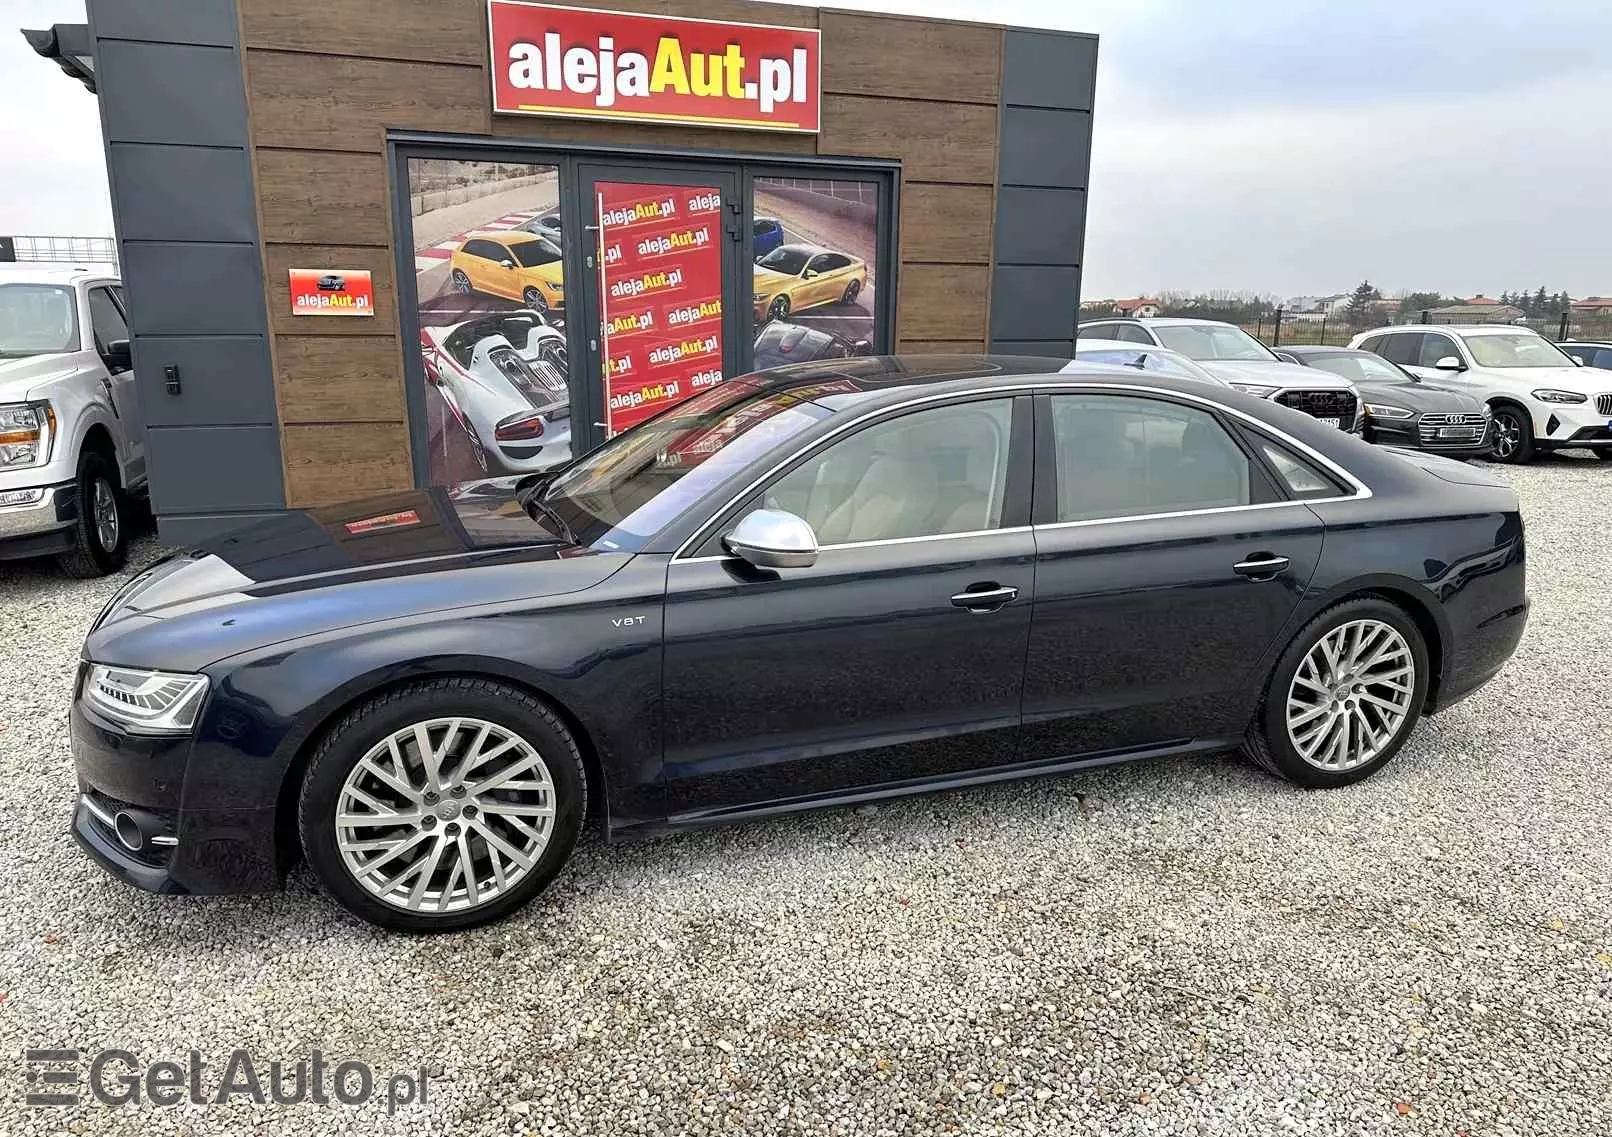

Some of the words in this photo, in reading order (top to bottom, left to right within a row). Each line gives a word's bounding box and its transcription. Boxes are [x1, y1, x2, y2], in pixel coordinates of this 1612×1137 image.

[508, 32, 808, 113] alejaAut.pl
[604, 198, 675, 225] alejaAut.pl
[688, 193, 720, 212] aleja
[638, 228, 709, 254] alejaAut.pl
[611, 269, 682, 296] alejaAut.pl
[297, 293, 368, 309] alejaAut.pl
[668, 301, 721, 324] alejaAut
[649, 336, 718, 363] alejaAut.pl
[691, 370, 722, 386] aleja
[610, 381, 679, 408] alejaAut.pl
[612, 616, 645, 627] V8T
